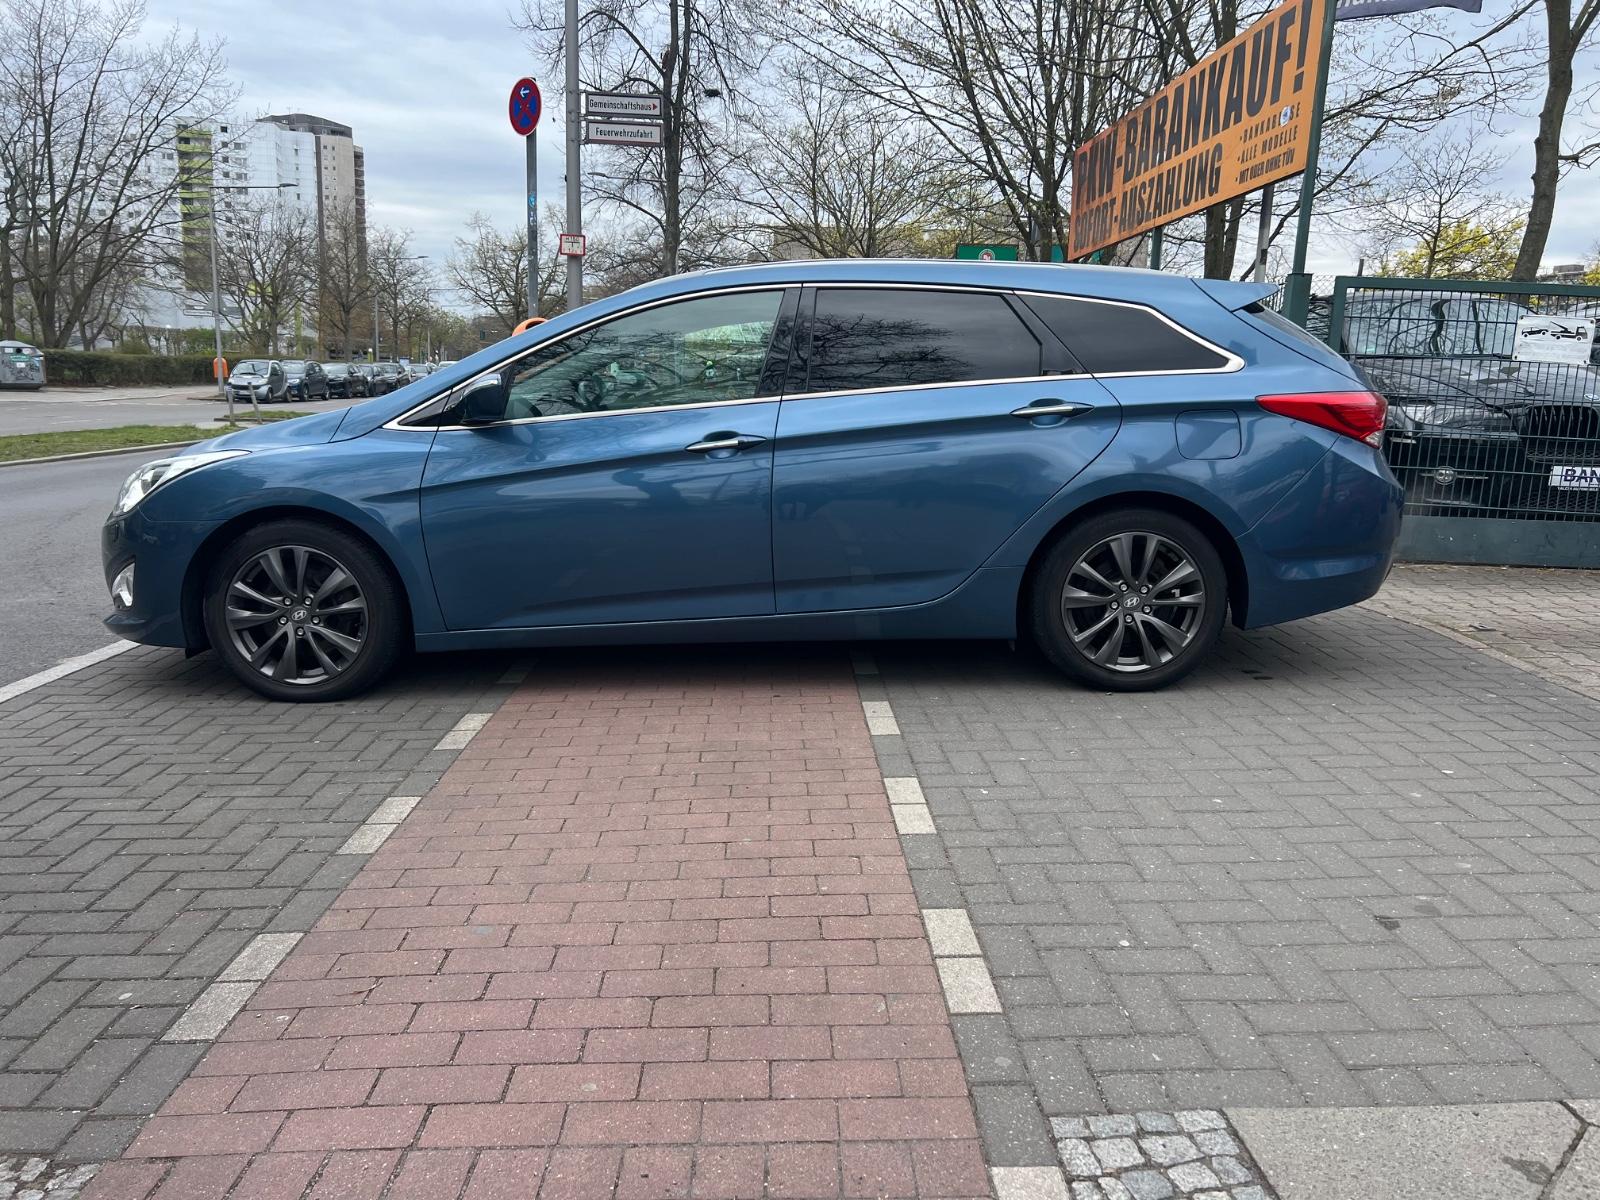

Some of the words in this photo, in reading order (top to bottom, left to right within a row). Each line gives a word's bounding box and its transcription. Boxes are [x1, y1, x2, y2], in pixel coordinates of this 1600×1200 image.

[590, 99, 652, 111] Gemeinschaftshaus
[1076, 0, 1312, 210] PKW-BARANKAUF!
[595, 126, 653, 139] Feuerwehrzufahrt
[1241, 144, 1257, 163] ALLE
[1261, 125, 1298, 154] MODELLE
[1239, 168, 1249, 184] MIT
[1073, 143, 1223, 253] SOFORT-AUSZAHLUNG
